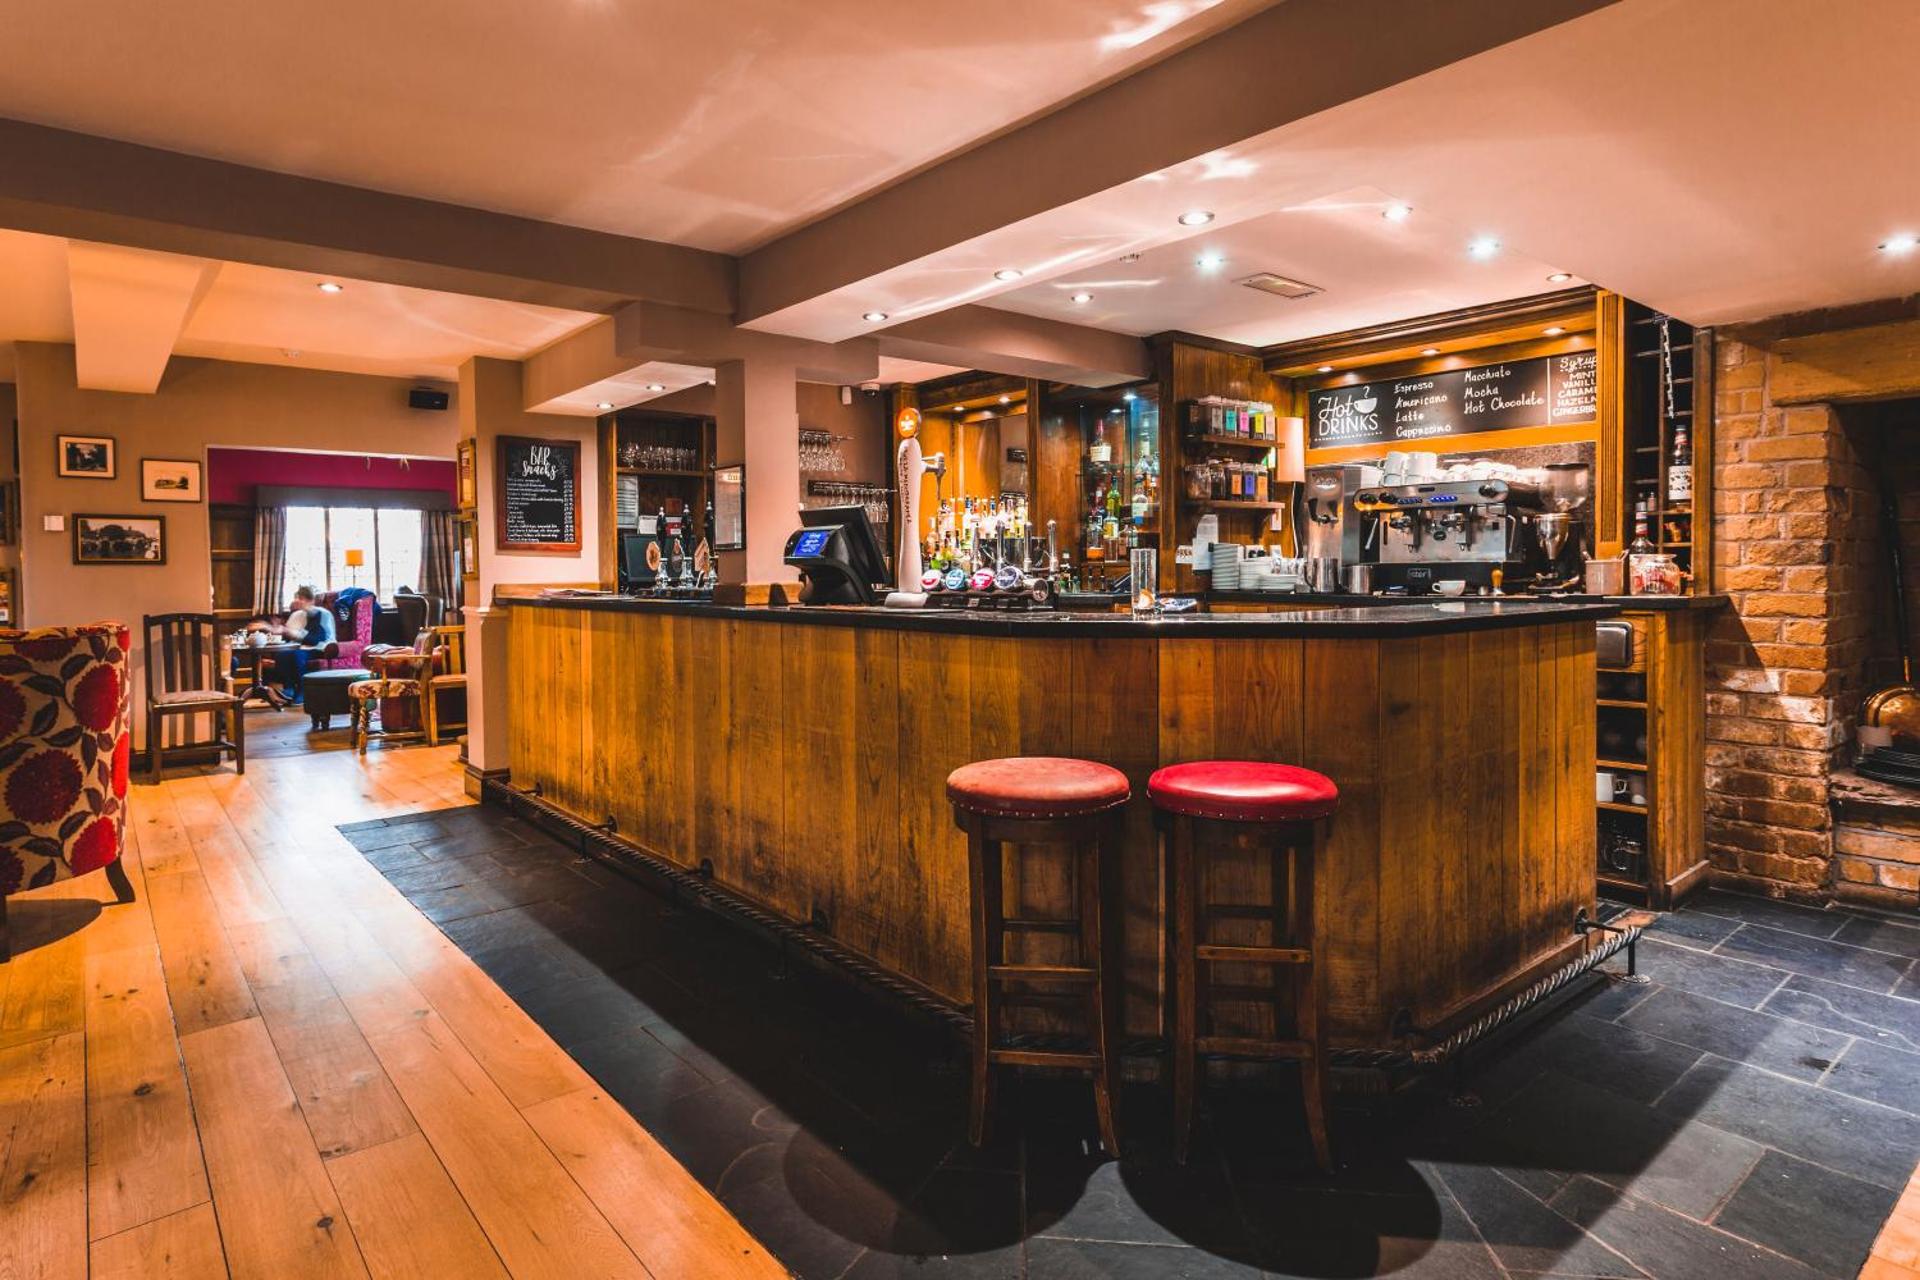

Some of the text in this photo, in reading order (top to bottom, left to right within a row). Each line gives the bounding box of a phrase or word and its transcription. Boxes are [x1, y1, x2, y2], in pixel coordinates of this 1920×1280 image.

[1464, 366, 1511, 382] Macchiato
[1394, 382, 1433, 394] Espresso
[1464, 384, 1499, 399] Mocha
[1318, 394, 1354, 420] Hot
[1395, 394, 1448, 409] Americano
[1464, 390, 1545, 414] Hot Chocolate
[1319, 413, 1378, 435] DRINKS
[1395, 410, 1424, 423] Latte
[531, 446, 550, 465] BAR
[522, 461, 558, 480] Snacks
